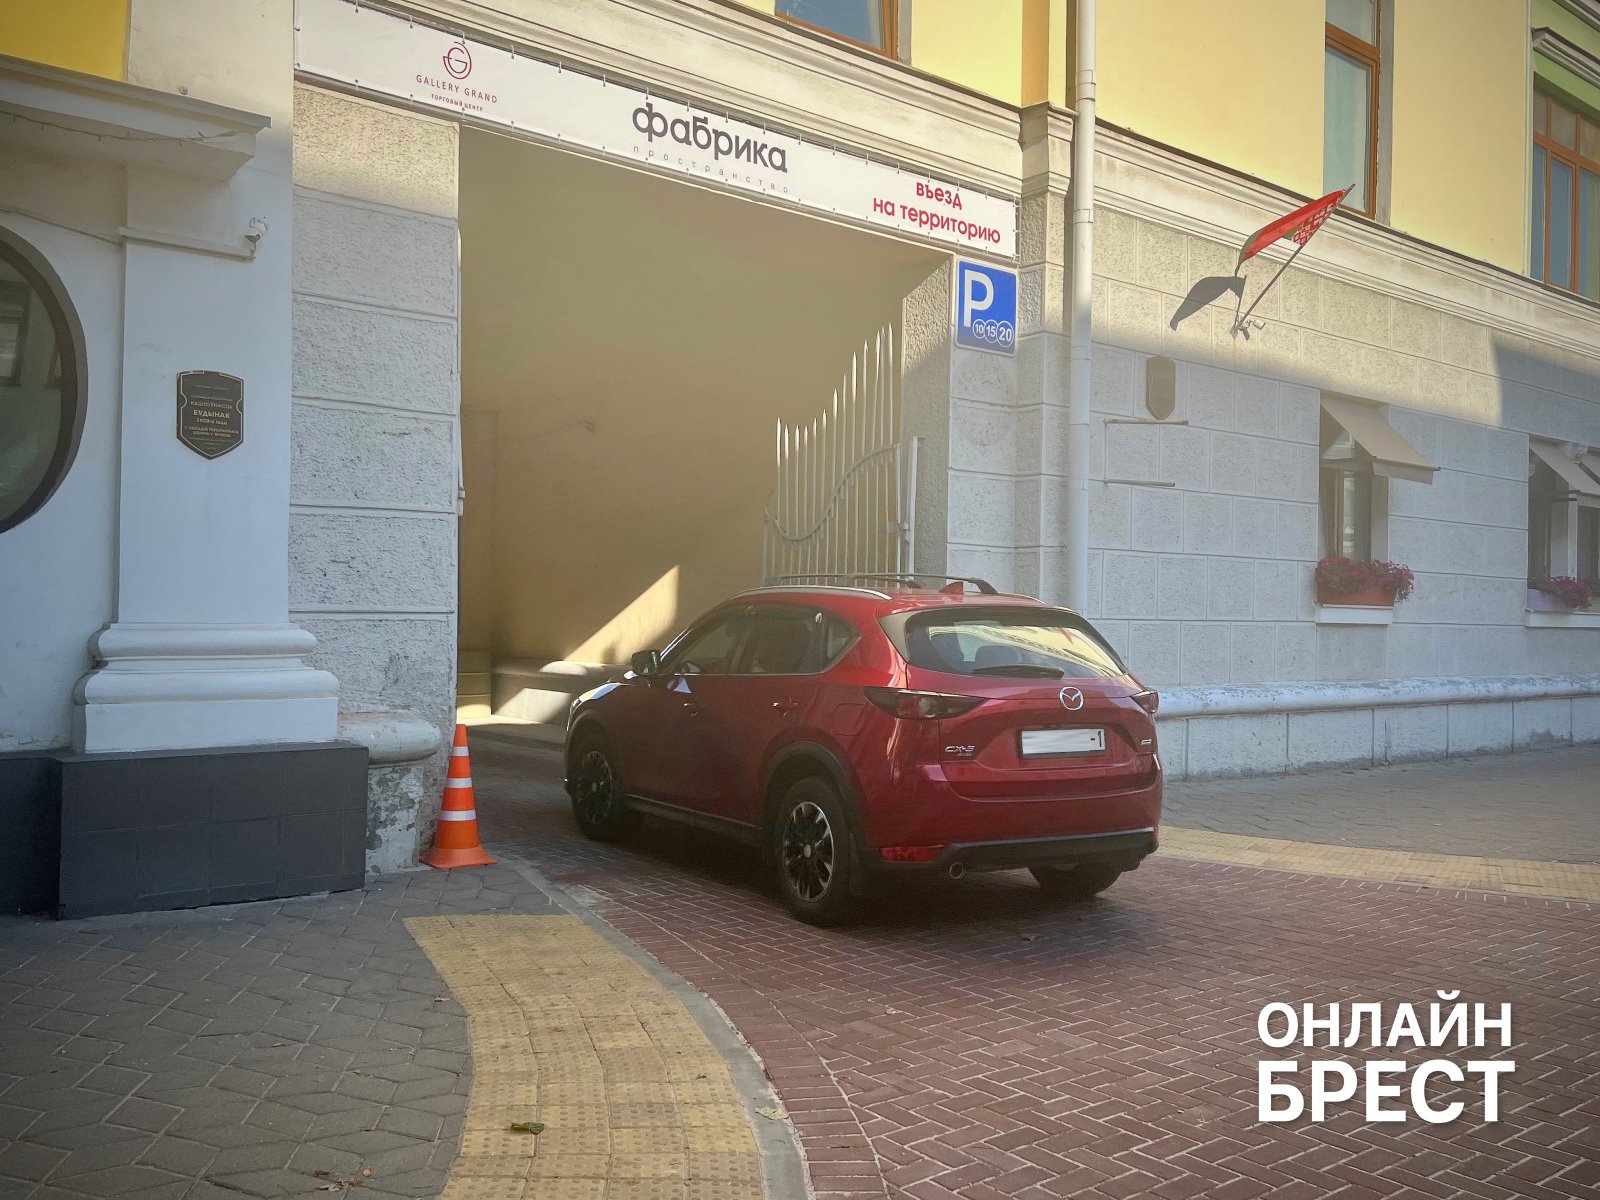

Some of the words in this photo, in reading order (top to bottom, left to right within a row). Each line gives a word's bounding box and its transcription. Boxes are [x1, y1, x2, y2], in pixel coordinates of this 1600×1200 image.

[416, 74, 460, 93] GALLERY
[464, 87, 498, 103] GRAND
[431, 93, 463, 107] ТОРГОВЫЙ
[464, 102, 484, 112] ЦЕНТР
[632, 102, 788, 173] фабрика
[633, 145, 788, 194] пространство
[916, 182, 963, 211] въезд
[873, 197, 895, 217] на
[900, 204, 1001, 244] территорию
[963, 269, 995, 328] P
[975, 324, 985, 334] 10
[986, 325, 997, 338] 15
[999, 326, 1013, 342] 20
[193, 409, 231, 419] БУДЫНАК
[944, 745, 976, 753] CX-5
